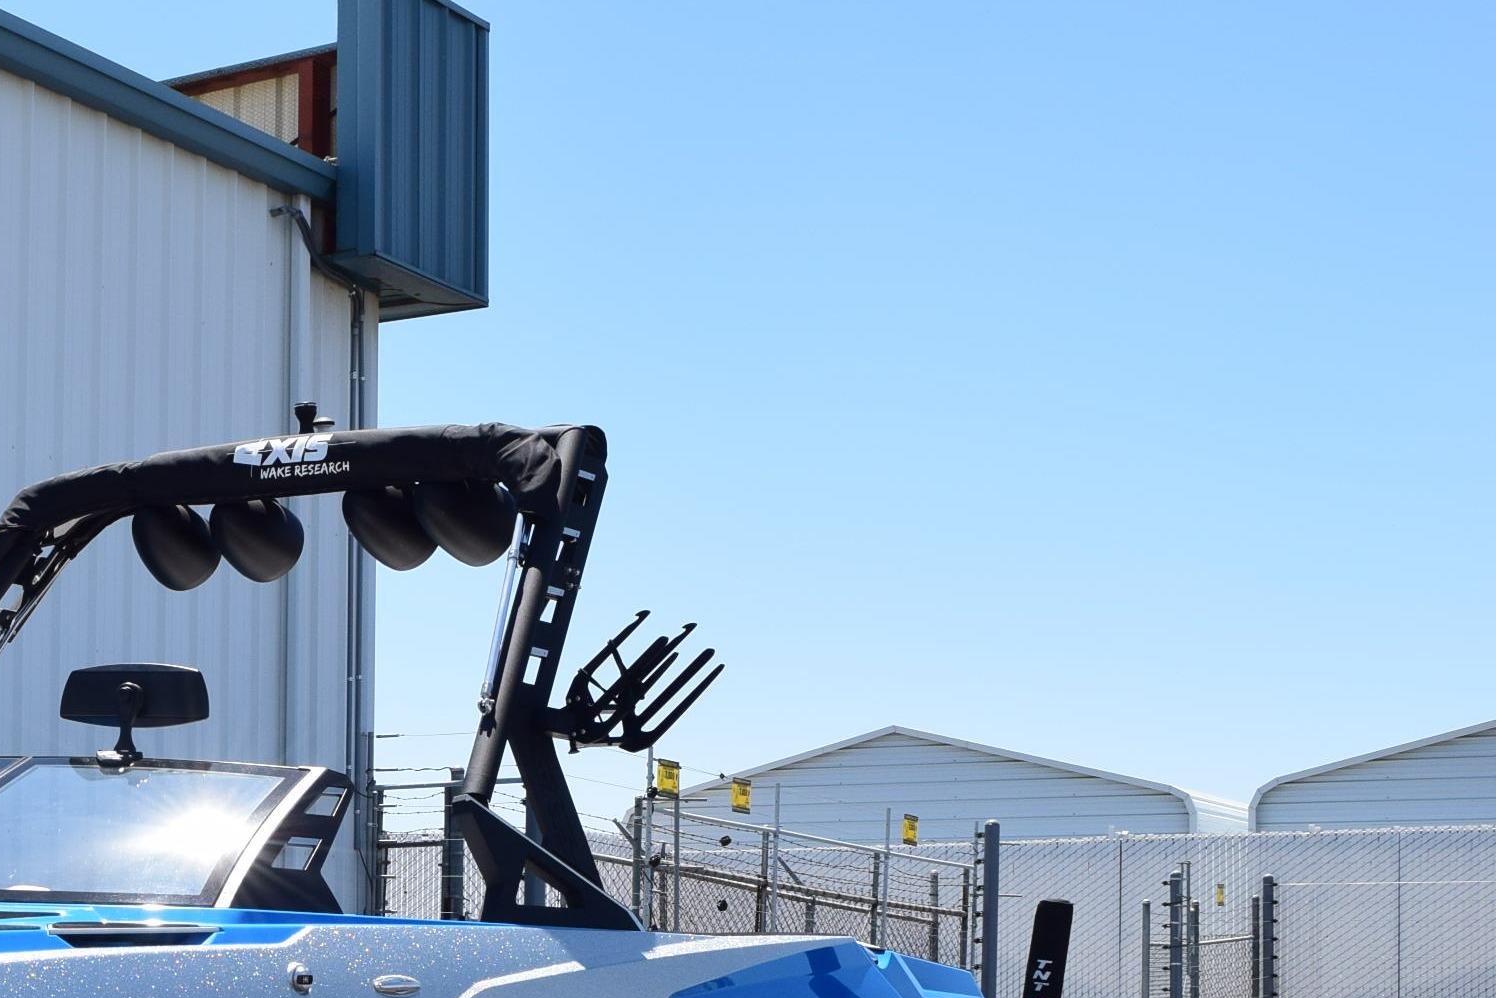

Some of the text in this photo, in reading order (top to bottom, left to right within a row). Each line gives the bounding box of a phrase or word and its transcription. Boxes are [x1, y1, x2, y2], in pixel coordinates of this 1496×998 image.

[260, 461, 350, 480] WAKE RESEARCH
[1030, 959, 1053, 992] TNT
